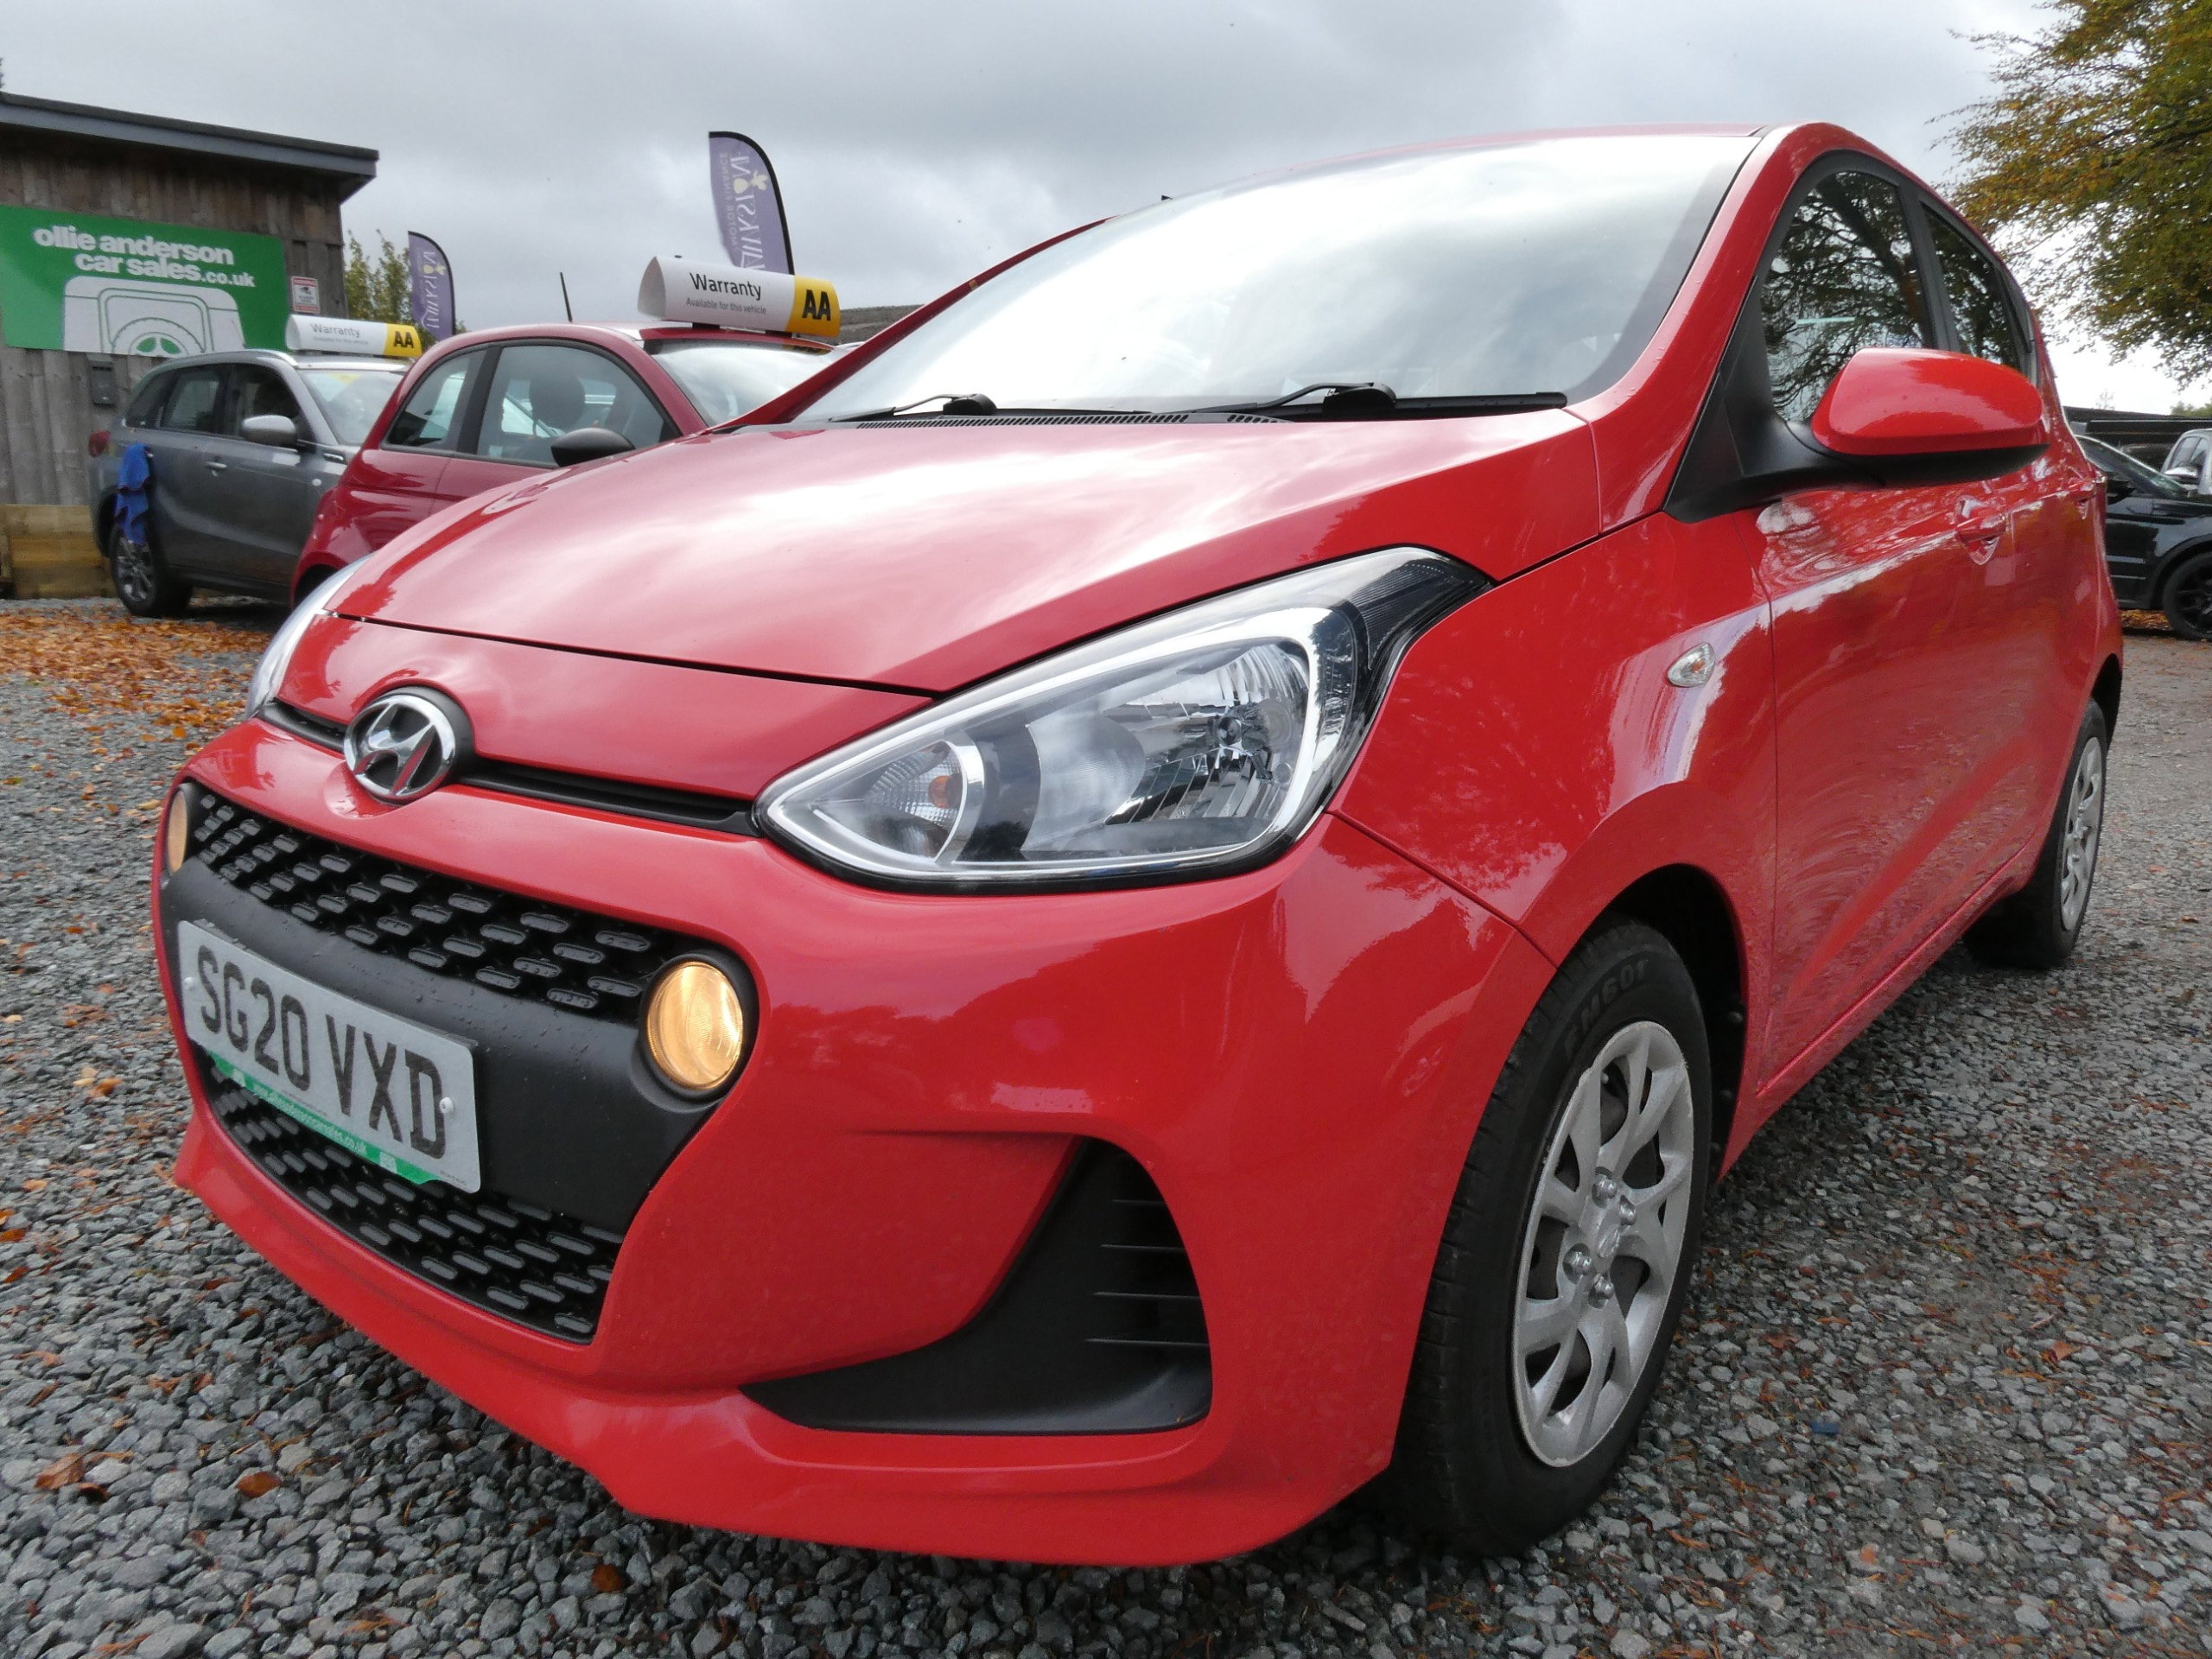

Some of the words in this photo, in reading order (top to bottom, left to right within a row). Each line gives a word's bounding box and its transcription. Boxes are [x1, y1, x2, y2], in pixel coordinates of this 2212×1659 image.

[34, 226, 97, 251] ollie
[99, 235, 234, 265] anderson
[74, 253, 123, 273] car
[690, 272, 761, 301] Warranty
[686, 297, 717, 309] Available
[719, 301, 728, 310] for
[730, 302, 742, 312] this
[744, 303, 767, 315] vehicle
[802, 289, 831, 321] AA
[310, 322, 360, 338] Warranty
[393, 331, 415, 348] AA
[197, 944, 311, 1091] SG20
[325, 1014, 447, 1160] VXD
